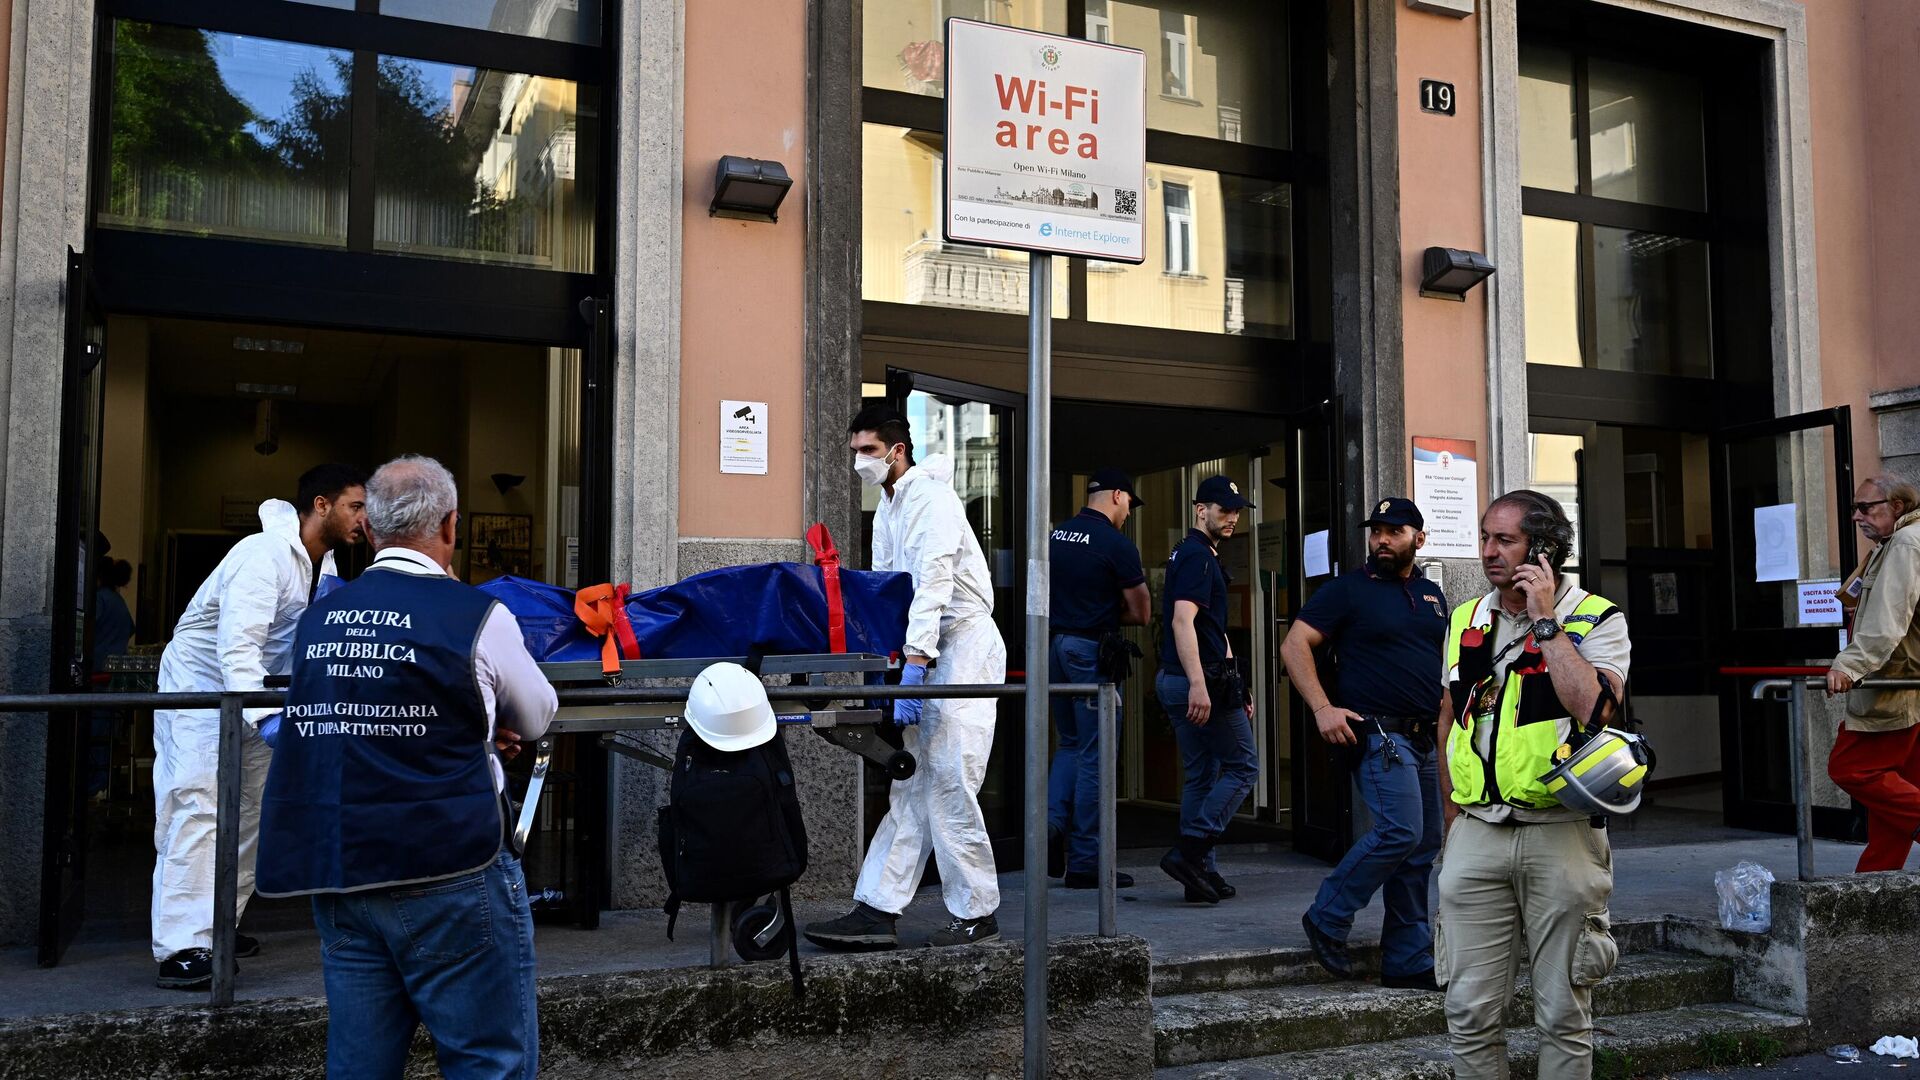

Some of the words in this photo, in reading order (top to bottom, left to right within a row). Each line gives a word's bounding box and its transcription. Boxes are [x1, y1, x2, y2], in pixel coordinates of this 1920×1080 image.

[994, 73, 1099, 124] Wi-Fi
[1424, 83, 1451, 110] 19
[995, 119, 1098, 160] area
[1013, 161, 1035, 173] Open
[1037, 164, 1059, 176] Wi-Fi
[1060, 168, 1087, 179] Milano
[954, 213, 968, 222] Con
[969, 215, 976, 223] la
[977, 217, 1024, 229] partecipazione
[1024, 222, 1031, 230] di
[1055, 226, 1091, 240] Internet
[1093, 230, 1131, 245] Explorer
[1051, 529, 1090, 545] POLIZIA
[323, 609, 412, 629] PROCURA
[345, 628, 376, 637] DELLA
[305, 642, 417, 663] REPUBBLICA
[326, 663, 384, 679] MILANO
[286, 702, 333, 718] POLIZIA
[334, 702, 439, 718] GIUDIZIARIA
[295, 721, 315, 738] VI
[317, 721, 427, 737] DIPARTIMENTO
